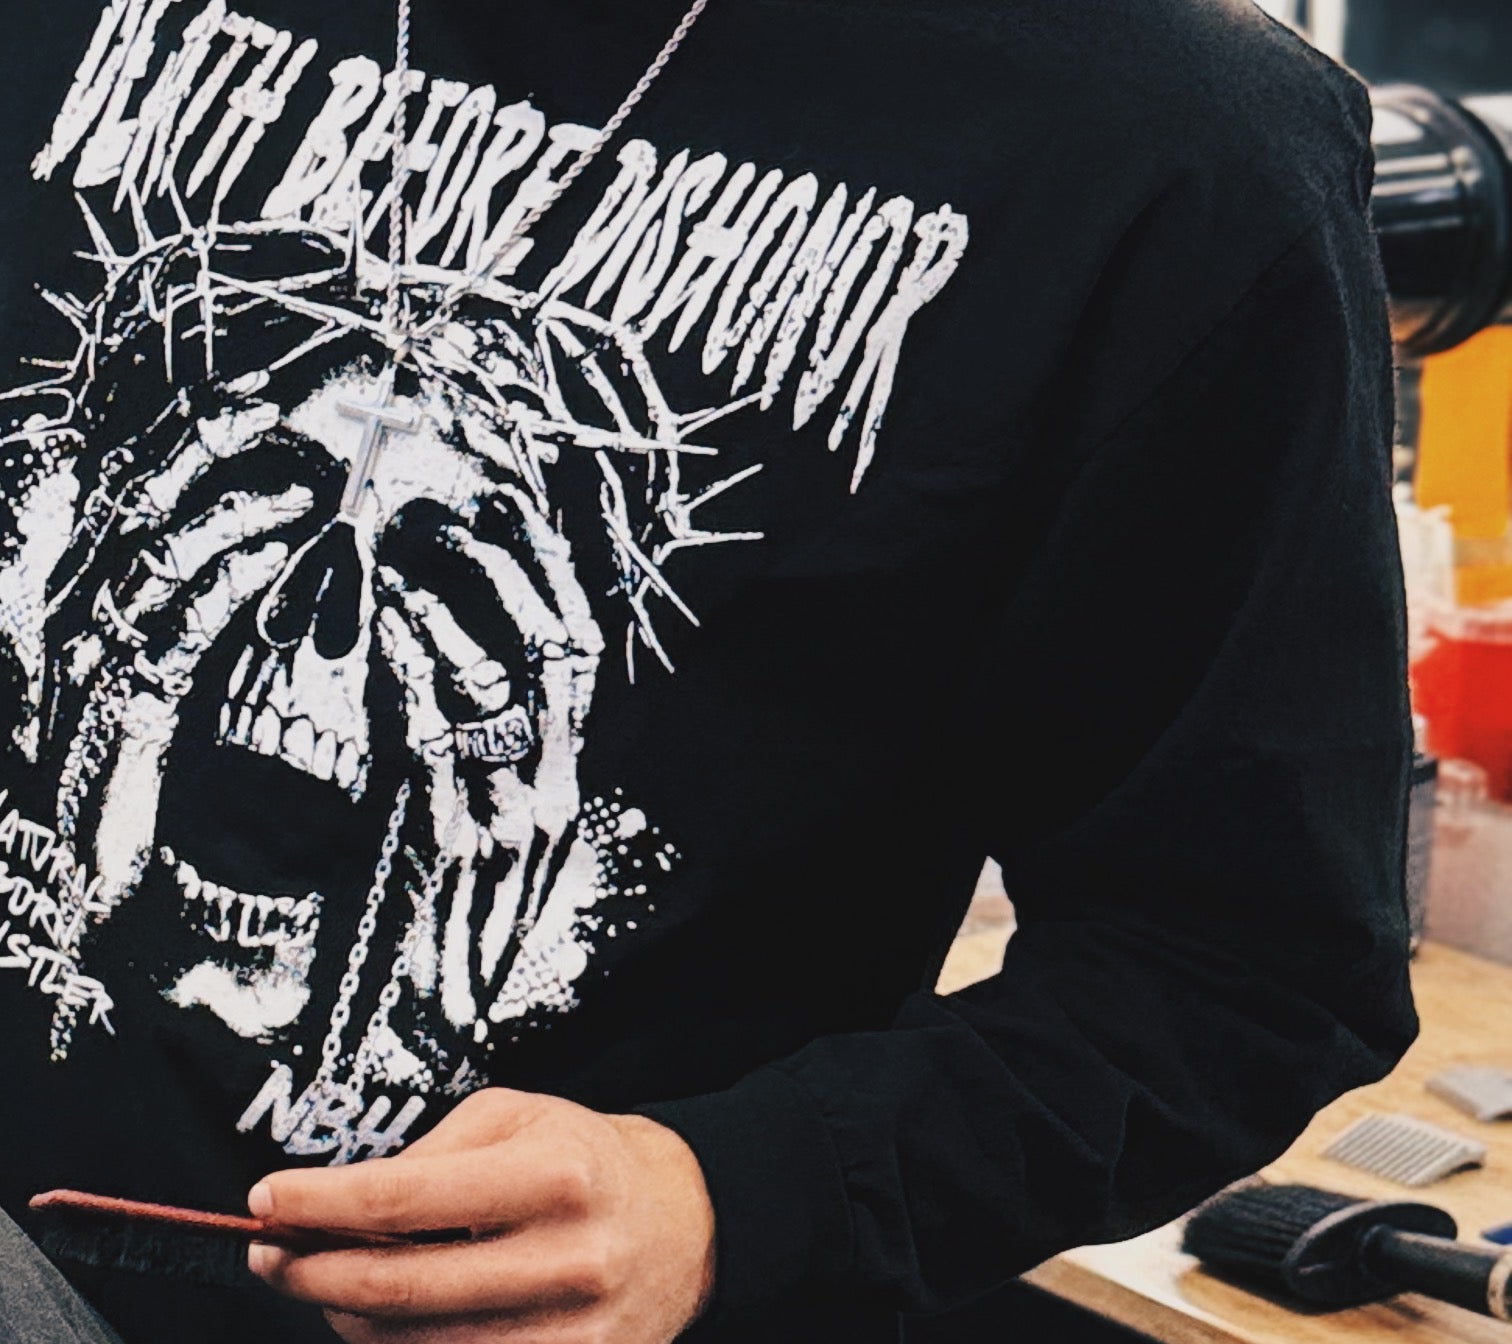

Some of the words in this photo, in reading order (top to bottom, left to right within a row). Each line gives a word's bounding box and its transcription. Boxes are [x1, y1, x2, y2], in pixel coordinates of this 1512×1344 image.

[260, 55, 605, 276] BEFORE
[538, 138, 969, 494] DISHONOR
[235, 1063, 428, 1168] NBH
